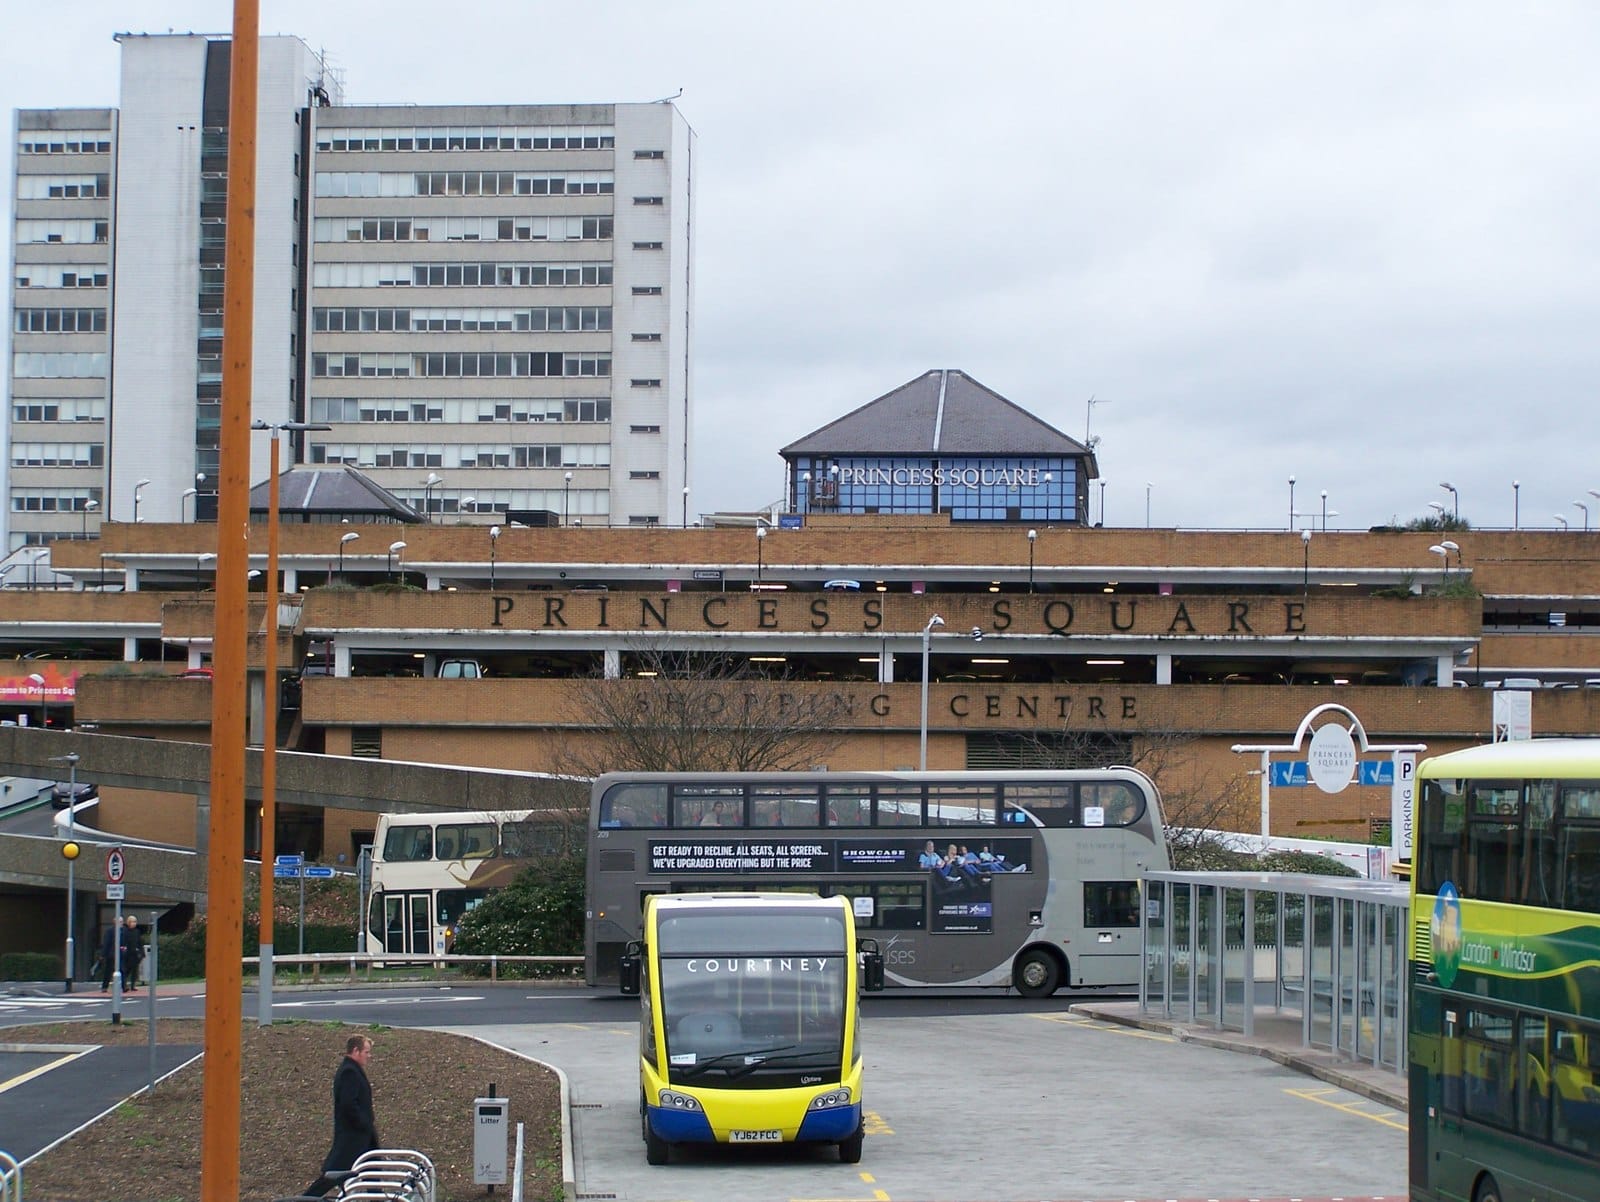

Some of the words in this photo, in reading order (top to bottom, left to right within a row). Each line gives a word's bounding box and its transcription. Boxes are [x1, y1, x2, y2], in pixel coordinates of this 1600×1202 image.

[841, 468, 945, 486] PRINCESS
[950, 468, 1040, 490] SQUARE
[491, 596, 882, 629] PRINCESS
[993, 600, 1306, 636] SQUARE
[19, 687, 27, 695] to
[950, 694, 1137, 718] CENTRE
[1313, 751, 1352, 759] PRINCESS
[1318, 759, 1349, 767] SQUARE
[1402, 762, 1412, 778] P
[1402, 789, 1413, 848] PARKING
[653, 846, 667, 856] GET
[668, 846, 692, 856] READY
[693, 846, 703, 856] TO
[736, 846, 750, 856] ALL
[751, 846, 775, 857] SEATS,
[776, 846, 788, 856] ALL
[653, 858, 676, 868] WE'VE
[677, 858, 715, 868] UPGRADED
[715, 858, 759, 868] EVERYTHING
[760, 858, 775, 868] BUT
[776, 858, 789, 868] THE
[791, 858, 812, 868] PRICE
[1461, 936, 1492, 965] London
[1501, 941, 1537, 972] Windsor
[687, 958, 828, 973] COURTNEY
[480, 1117, 500, 1125] Litter
[734, 1130, 758, 1140] YJ62
[760, 1130, 778, 1140] FCC
